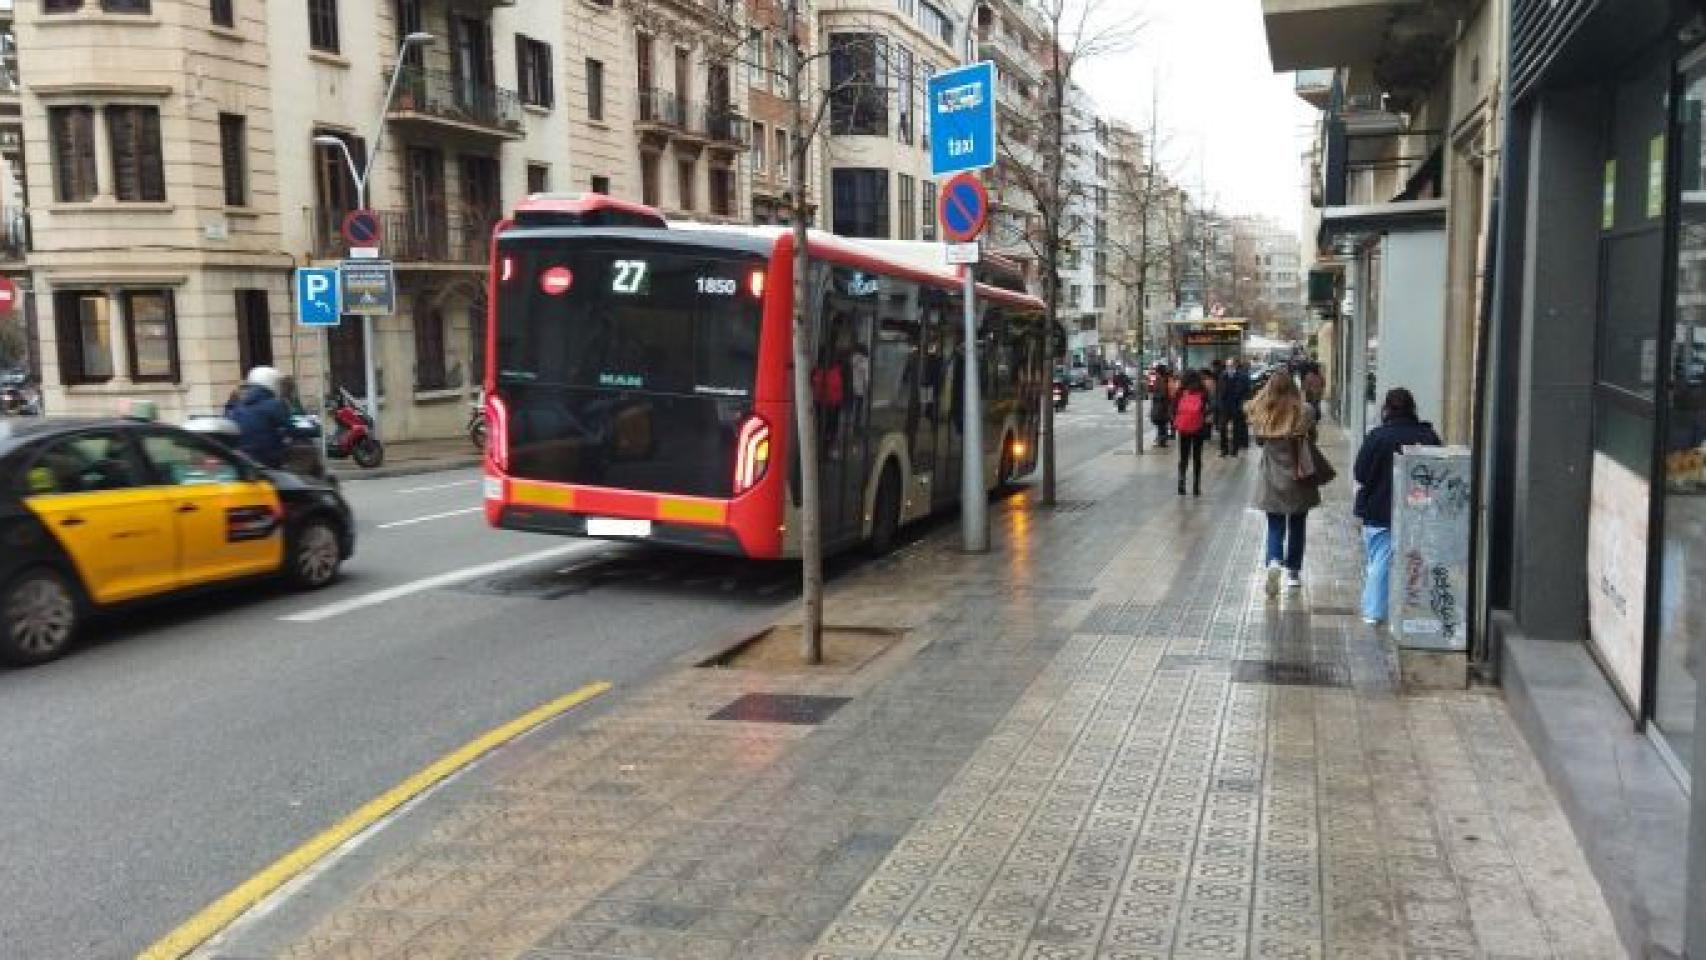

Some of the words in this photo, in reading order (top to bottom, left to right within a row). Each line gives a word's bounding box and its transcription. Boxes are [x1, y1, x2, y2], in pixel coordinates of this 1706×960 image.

[947, 134, 974, 156] taxi
[306, 273, 329, 301] P
[612, 259, 647, 293] 27
[696, 277, 737, 295] 1850
